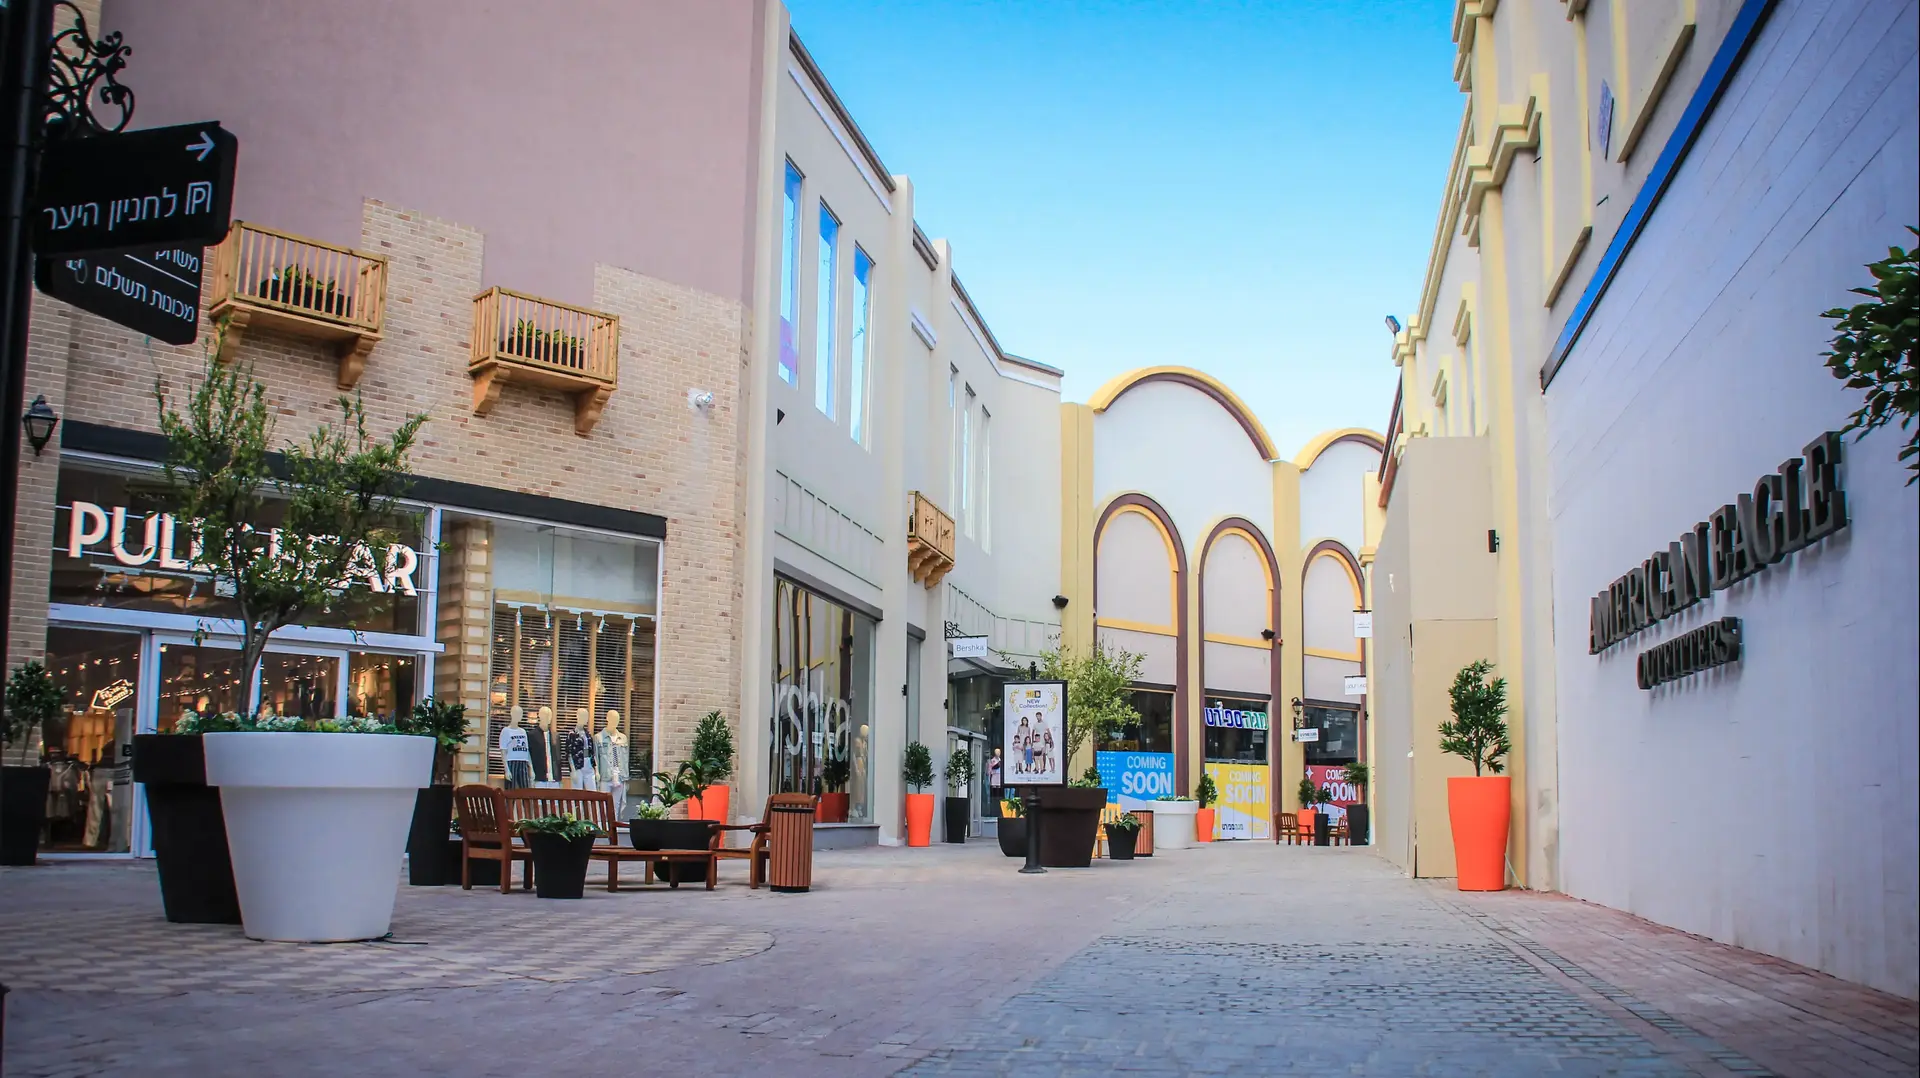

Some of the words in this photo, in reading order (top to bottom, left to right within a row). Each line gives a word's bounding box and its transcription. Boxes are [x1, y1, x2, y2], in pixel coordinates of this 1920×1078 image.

[43, 202, 99, 230] היער
[108, 186, 177, 231] לחניון
[95, 265, 147, 302] תשלום
[149, 289, 195, 322] מכונות
[1588, 521, 1711, 656] AMERICAN
[1709, 430, 1848, 591] EAGLE
[956, 644, 985, 652] Bershka
[1636, 616, 1739, 690] OUTFITTERS
[770, 665, 851, 762] rshka
[1127, 755, 1167, 769] COMING
[1229, 771, 1262, 783] COMING
[1121, 771, 1172, 795] SOON
[1225, 783, 1267, 804] SOON
